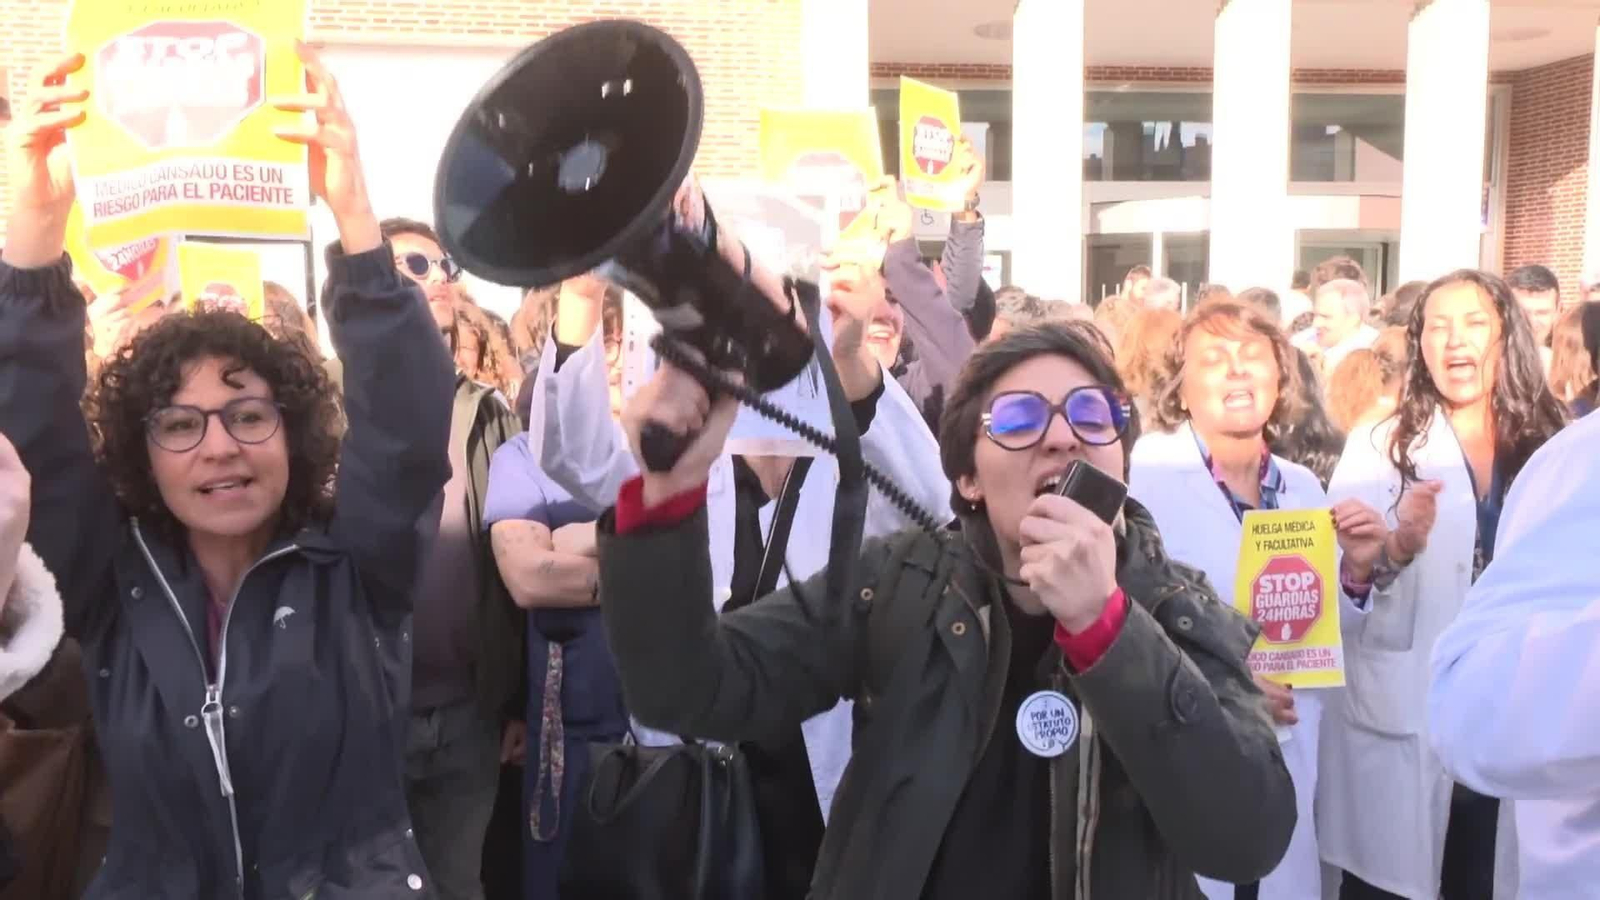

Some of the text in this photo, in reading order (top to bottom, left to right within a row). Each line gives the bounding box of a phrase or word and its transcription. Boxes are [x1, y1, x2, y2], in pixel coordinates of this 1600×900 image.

[233, 164, 255, 182] ES
[260, 166, 284, 184] UN
[93, 182, 294, 218] RIESGO PARA EL PACIENTE
[1252, 523, 1282, 535] HUELGA
[1255, 537, 1315, 551] Y FACULTATIVA
[1259, 571, 1315, 593] STOP
[1255, 589, 1319, 609] GUARDIAS
[1257, 604, 1316, 623] 24HORAS
[1307, 648, 1317, 658] ES
[1297, 658, 1336, 669] PACIENTE
[1031, 708, 1064, 720] POR UN
